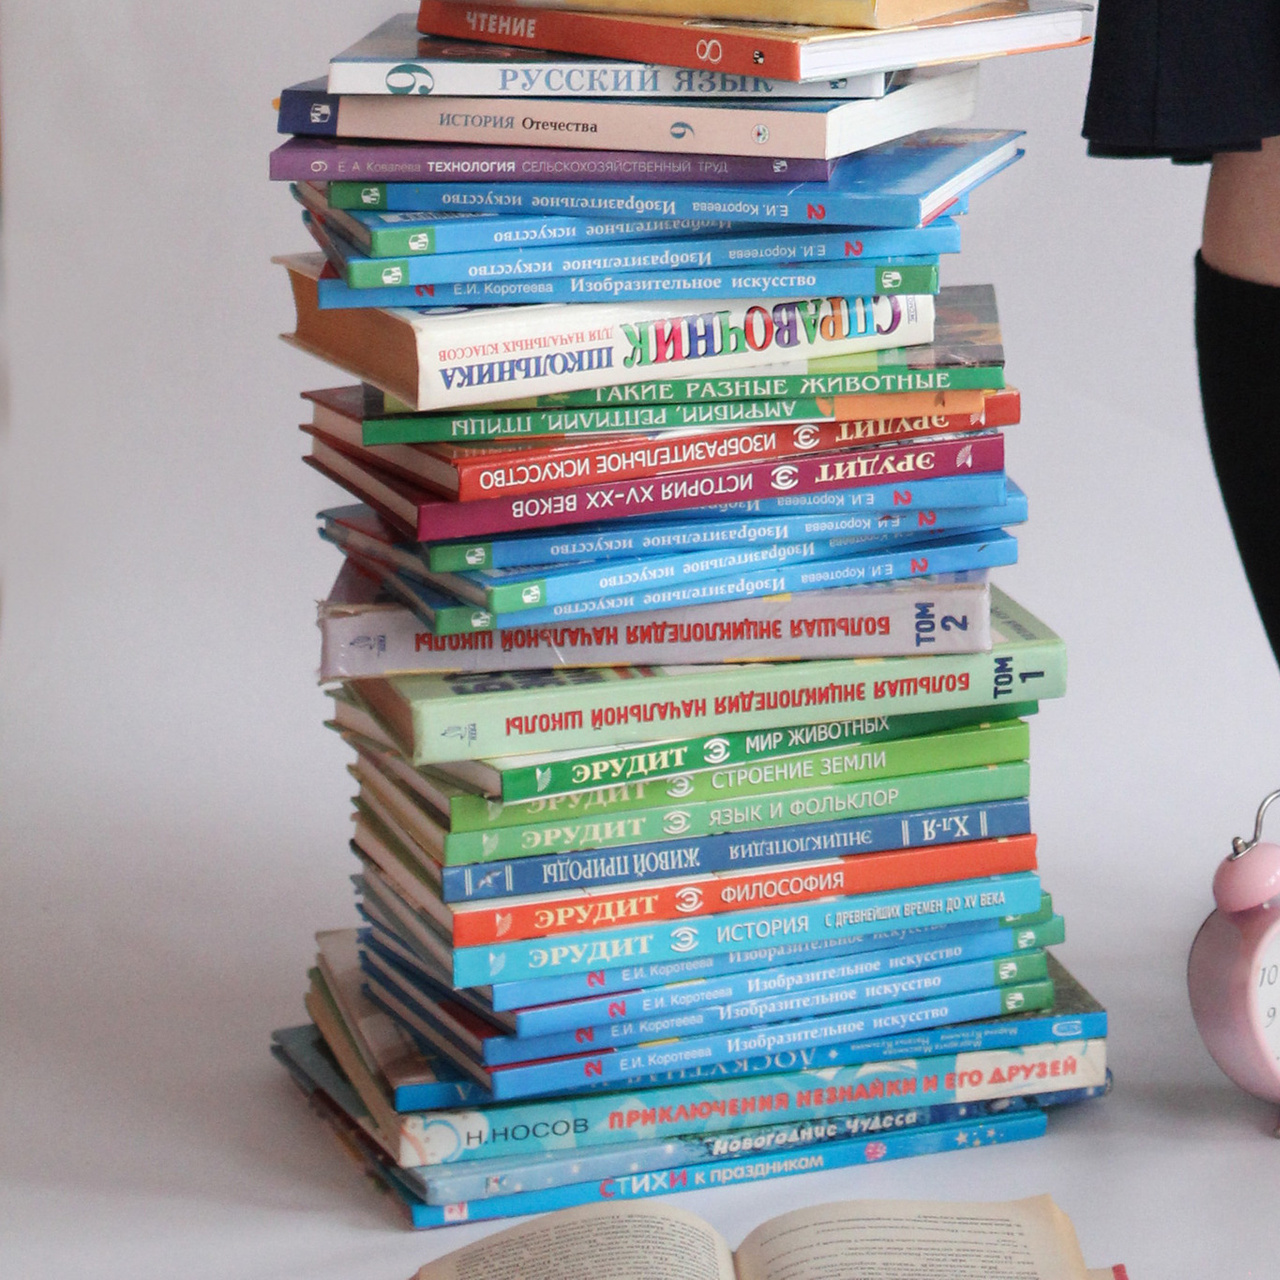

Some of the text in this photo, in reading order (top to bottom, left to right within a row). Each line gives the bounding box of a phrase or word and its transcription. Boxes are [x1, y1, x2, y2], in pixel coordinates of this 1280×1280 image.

[466, 11, 536, 38] ЧТЕНИЕ
[498, 64, 773, 93] РУССКИЙ ЯЗЫК
[439, 113, 598, 134] ИСТОРИЯ Отечества
[427, 159, 728, 175] ТЕХНОЛОГИЯ СЕЛЬСКОХОЗЯЙСТВЕННЫЙ ТРУД
[442, 193, 826, 220] 2 Коротеева Изобразительное искусство
[494, 226, 576, 244] искусство
[468, 240, 863, 278] 2 Коротеева Изобразительное искусство
[484, 274, 816, 296] Коротеева Изобразительное искусство
[438, 331, 586, 362] НАЧАЛЬНЫХ КЛАССОВ
[621, 294, 903, 369] СПРАВОЧНИК
[439, 346, 613, 390] ШКОЛЬНИКА
[594, 373, 951, 404] ТАКИЕ РАЗНЫЕ ЖИВОТНЫЕ
[451, 407, 667, 436] РЕПТИЛИИ, ПТИЦЫ
[480, 432, 776, 490] ИЗОБРАЗИТЕЛЬНОЕ ИСКУССТВО
[815, 451, 936, 484] ЭРУДИТ
[661, 473, 753, 500] ИСТОРИЯ
[512, 496, 577, 519] ВЕКОВ
[550, 519, 871, 556] Коротеева Изобразительное искусство
[600, 542, 815, 589] Изобразительное искусство
[643, 566, 865, 606] Коротеева Изобразительное
[415, 615, 890, 652] БОЛЬШАЯ ЭНЦИКЛОПЕДИЯ НАЧАЛЬНОЙ ШКОЛЫ
[915, 603, 935, 647] ТОМ
[941, 615, 968, 631] 2
[993, 656, 1013, 699] ТОМ
[1019, 671, 1044, 683] 1
[505, 672, 970, 736] БОЛЬШАЯ ЭНЦИКЛОПЕДИЯ НАЧАЛЬНОЙ ШКОЛЫ
[571, 715, 889, 784] ЭРУДИТ МИР ЖИВОТНЫХ
[712, 751, 886, 790] СТРОЕНИЕ ЗЕМЛИ
[521, 788, 899, 849] ЭРУДИТ ЯЗЫК ФОЛЬКЛОР
[633, 847, 700, 873] ЖИВОЙ
[729, 830, 873, 860] ЭНЦИКЛОПЕДИЯ
[543, 855, 629, 883] ПРИРОДЫ
[534, 871, 844, 929] ЭРУДИТ ФИЛОСОФИЯ
[528, 904, 901, 969] ЭРУДИТ ИСТОРИЯ ДРЕВНЕЙШИХ
[649, 957, 713, 976] Коротеева
[671, 945, 962, 1008] Коротеева Изобразительное искусство
[1259, 965, 1278, 987] 10
[640, 975, 942, 1034] Коротеева Изобразительное искусство
[1266, 1006, 1277, 1027] 9
[648, 1044, 712, 1068] Коротеева
[727, 1018, 864, 1054] Изобразительное
[873, 1004, 949, 1028] искусство
[608, 1092, 789, 1131] ПРИКЛЮЧЕНИЯ
[797, 1075, 917, 1107] НЕЗНАЙКИ
[923, 1074, 938, 1092] И
[945, 1069, 984, 1092] ЕГО
[988, 1054, 1077, 1085] ДРУЗЕЙ
[600, 1154, 824, 1198] СТИХИ праздникам
